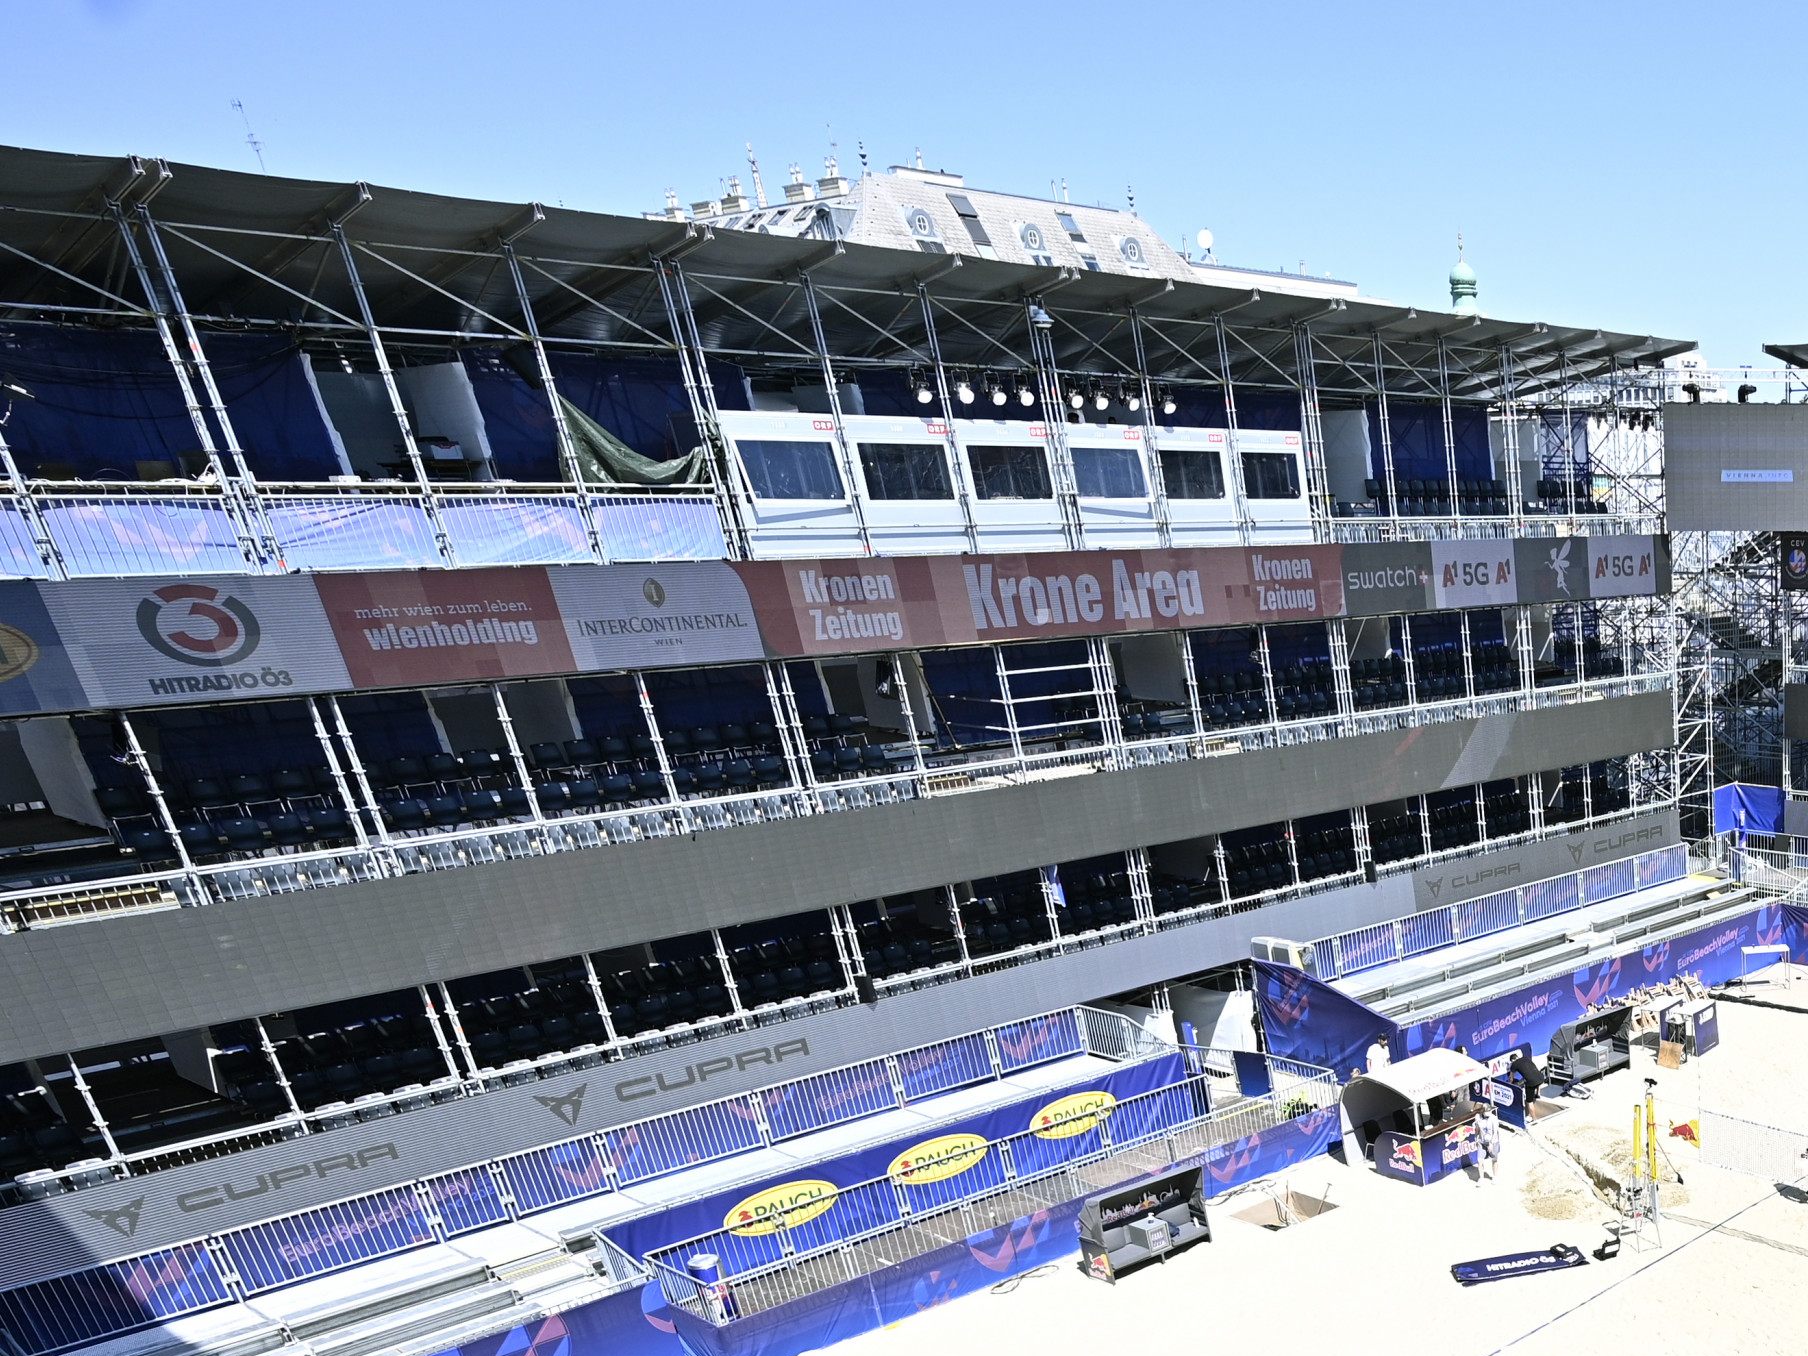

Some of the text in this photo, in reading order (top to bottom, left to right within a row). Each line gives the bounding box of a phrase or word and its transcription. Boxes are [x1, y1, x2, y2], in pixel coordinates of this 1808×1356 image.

[1790, 539, 1806, 548] CEV
[1251, 554, 1312, 582] Kronen
[1349, 564, 1417, 590] swatch
[1442, 558, 1511, 588] A1 5G A1
[1595, 552, 1651, 579] A1 5G A1
[799, 570, 896, 606] Kronen
[962, 558, 1205, 630] Krone Area
[1255, 583, 1316, 611] Zeitung
[354, 599, 533, 620] mehr wien zum leben.
[809, 606, 904, 641] Zeitung
[653, 637, 683, 647] WIEN
[149, 666, 294, 696] HITRADIO Ö3
[1593, 824, 1664, 855] CUPRA
[1451, 862, 1521, 888] CUPRA
[1677, 928, 1739, 970] EuroBeachVolley
[1472, 992, 1551, 1046] EuroBeachVolley
[1520, 1008, 1546, 1027] Vienna
[614, 1037, 811, 1102] CUPRA
[176, 1142, 400, 1213] CUPRA
[1486, 1258, 1540, 1272] HITRADIO
